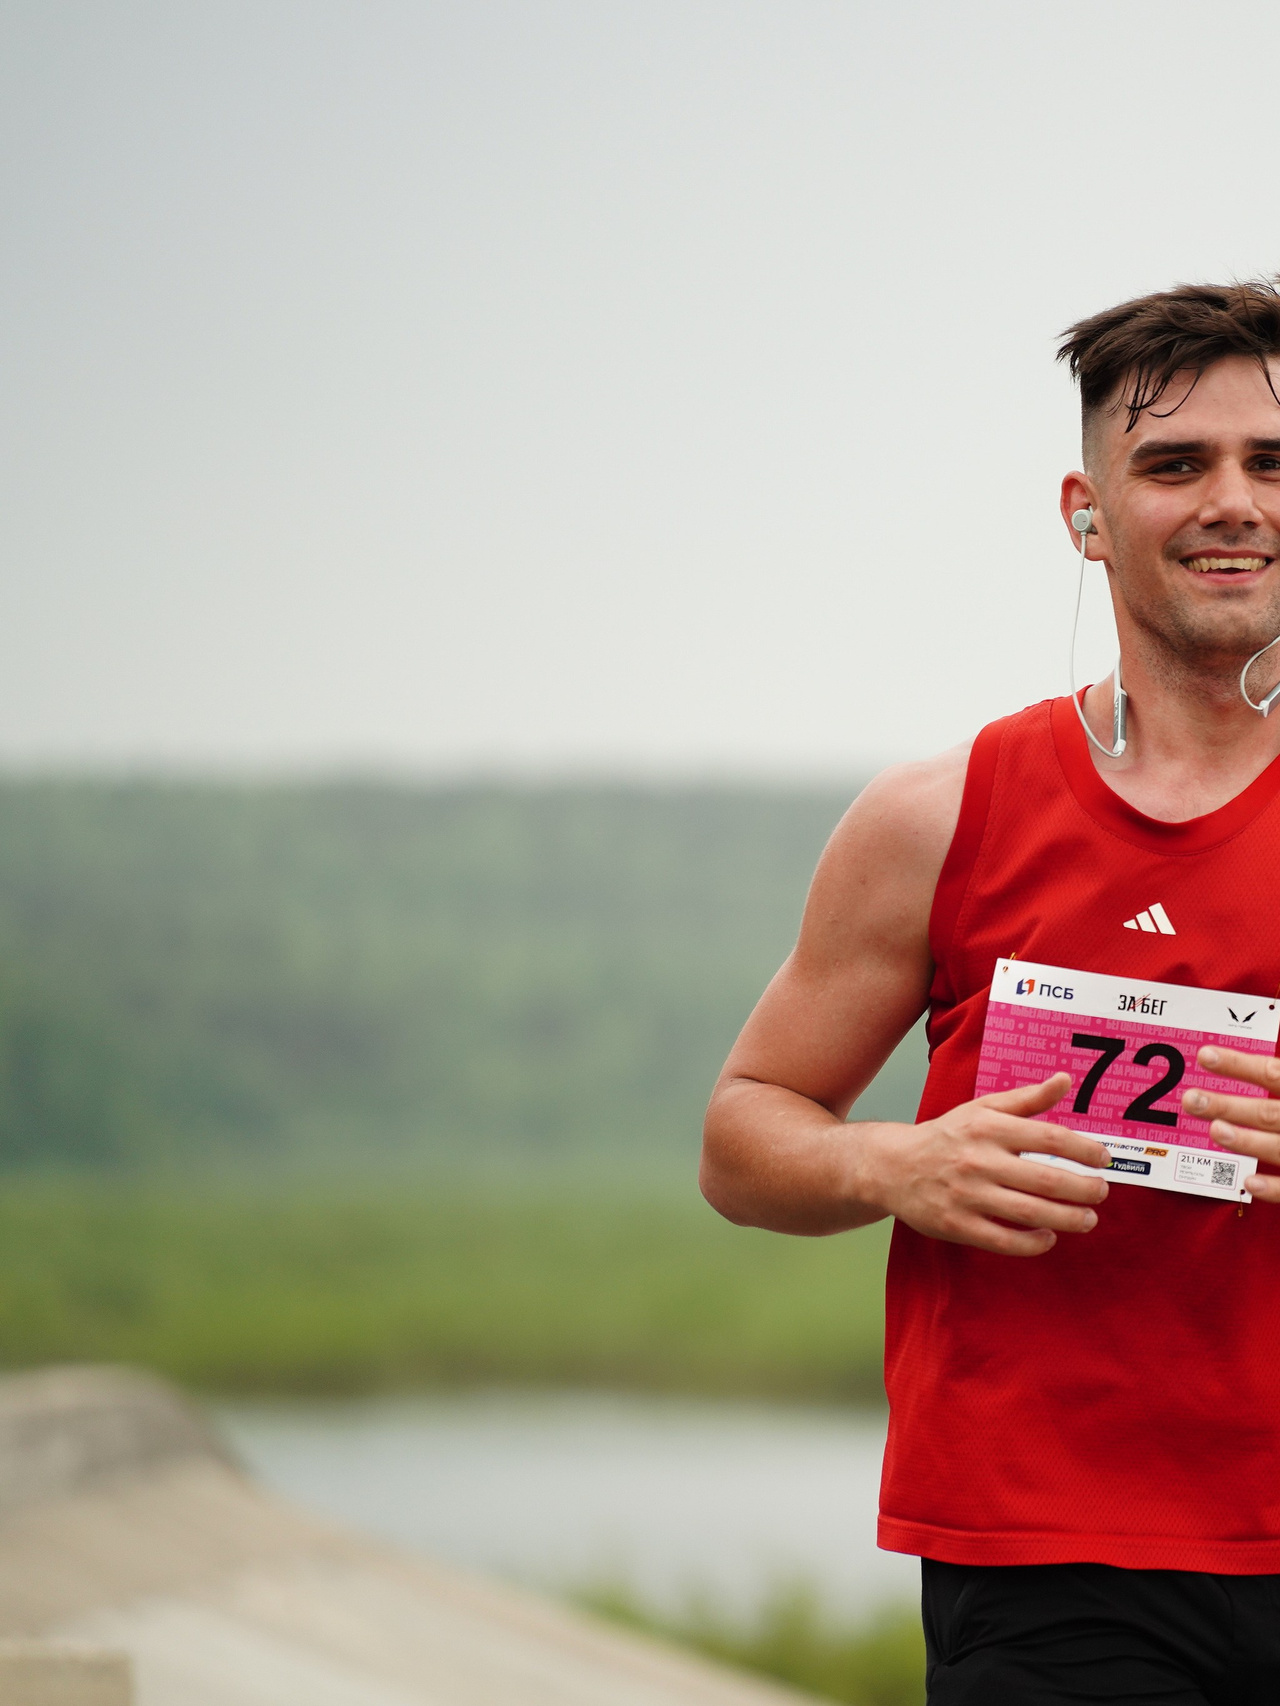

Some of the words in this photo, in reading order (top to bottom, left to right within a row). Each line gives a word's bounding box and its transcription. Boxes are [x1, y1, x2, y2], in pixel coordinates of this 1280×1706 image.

[1039, 983, 1074, 1000] ПСБ
[1027, 1021, 1039, 1034] НА
[1038, 1023, 1070, 1039] СТАРТЕ
[1003, 1032, 1019, 1045] БЕГ
[1018, 1034, 1026, 1046] В
[1025, 1035, 1047, 1050] СЕБЕ
[995, 1046, 1024, 1062] ДАВНО
[1024, 1050, 1056, 1066] ОТСТАЛ
[1009, 1064, 1043, 1080] ТОЛЬКО
[1112, 1063, 1124, 1075] ЗА
[1124, 1065, 1153, 1079] РАМКИ
[1071, 1033, 1186, 1127] 72
[1100, 1076, 1132, 1092] СТАРТЕ
[1204, 1076, 1265, 1096] ПЕРЕЗАГРУЗКА
[1135, 1126, 1147, 1139] НА
[1147, 1128, 1178, 1143] СТАРТЕ
[1145, 1147, 1168, 1157] PRO
